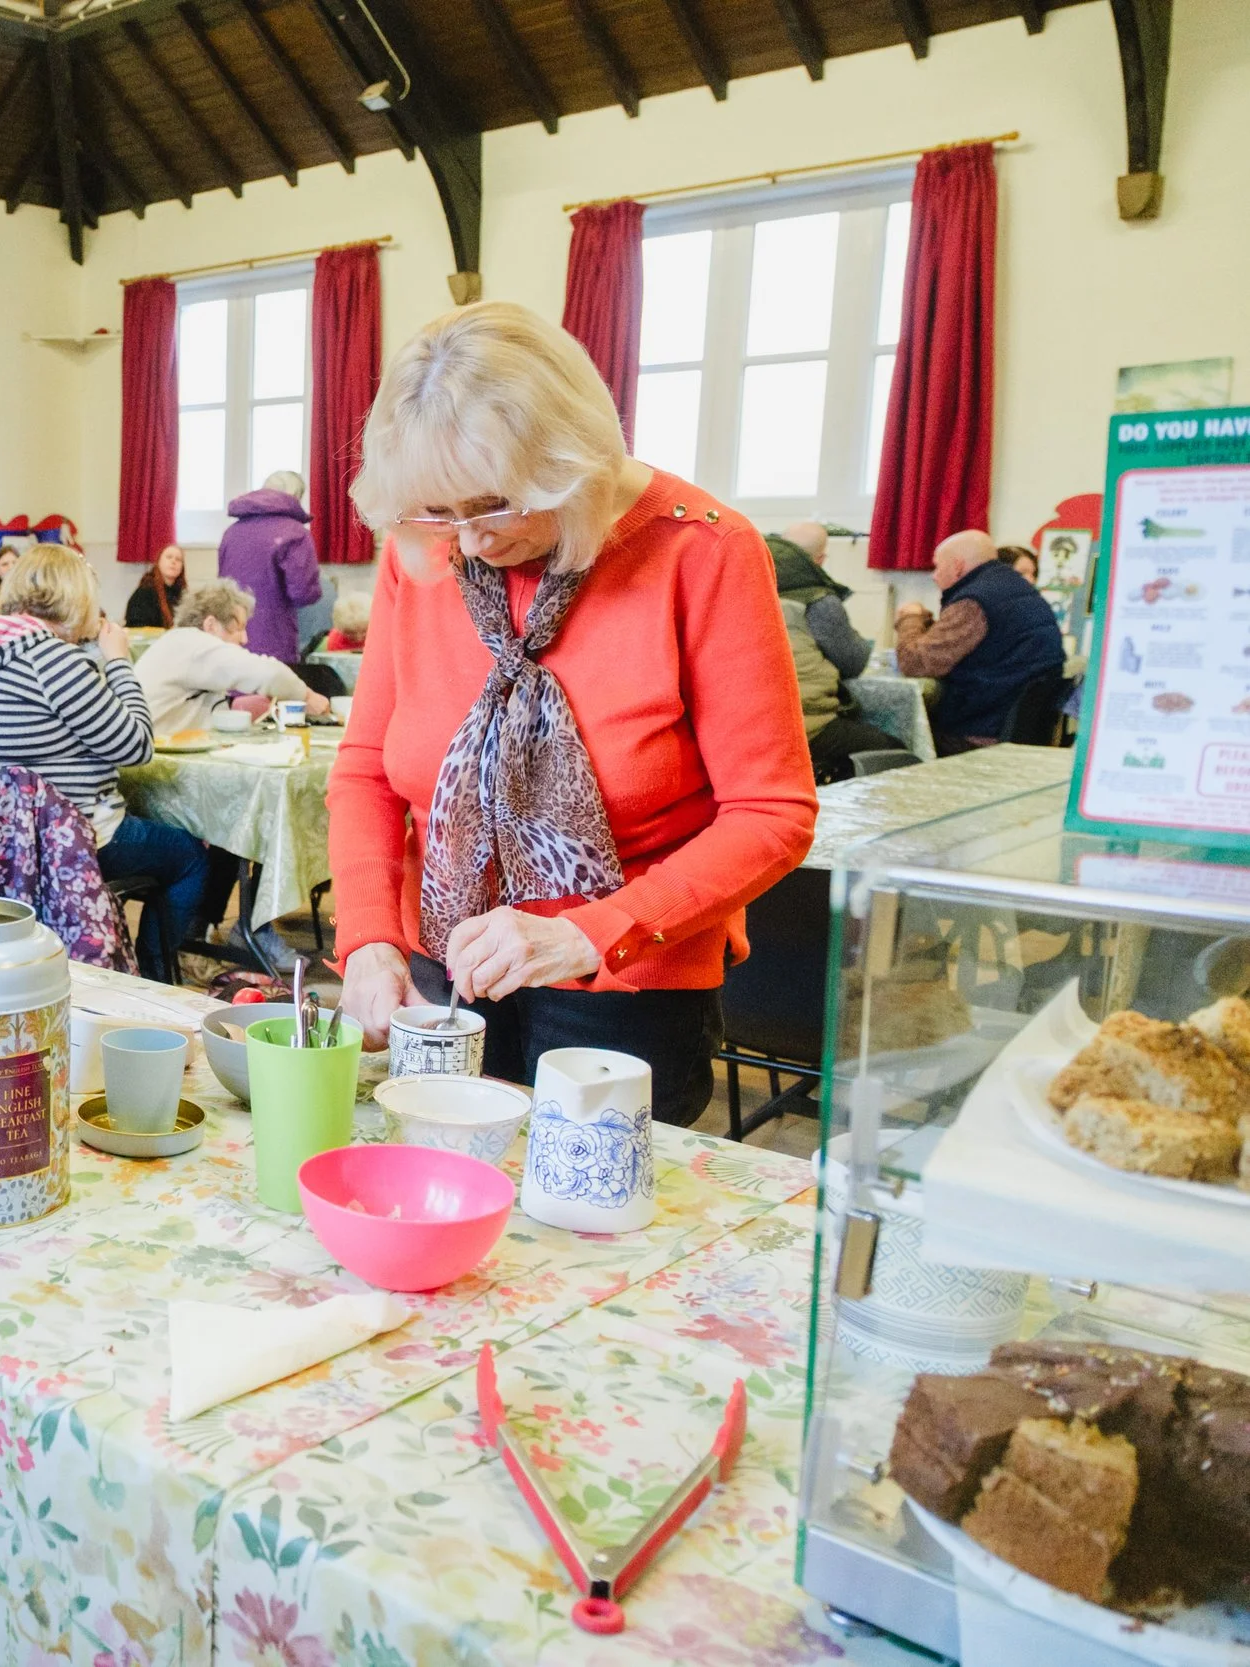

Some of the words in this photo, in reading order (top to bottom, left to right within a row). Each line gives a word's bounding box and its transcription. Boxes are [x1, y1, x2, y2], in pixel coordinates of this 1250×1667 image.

[1117, 422, 1149, 442] DO
[1154, 419, 1198, 441] YOU
[4, 1086, 31, 1100] FINE
[6, 1127, 29, 1142] TEA
